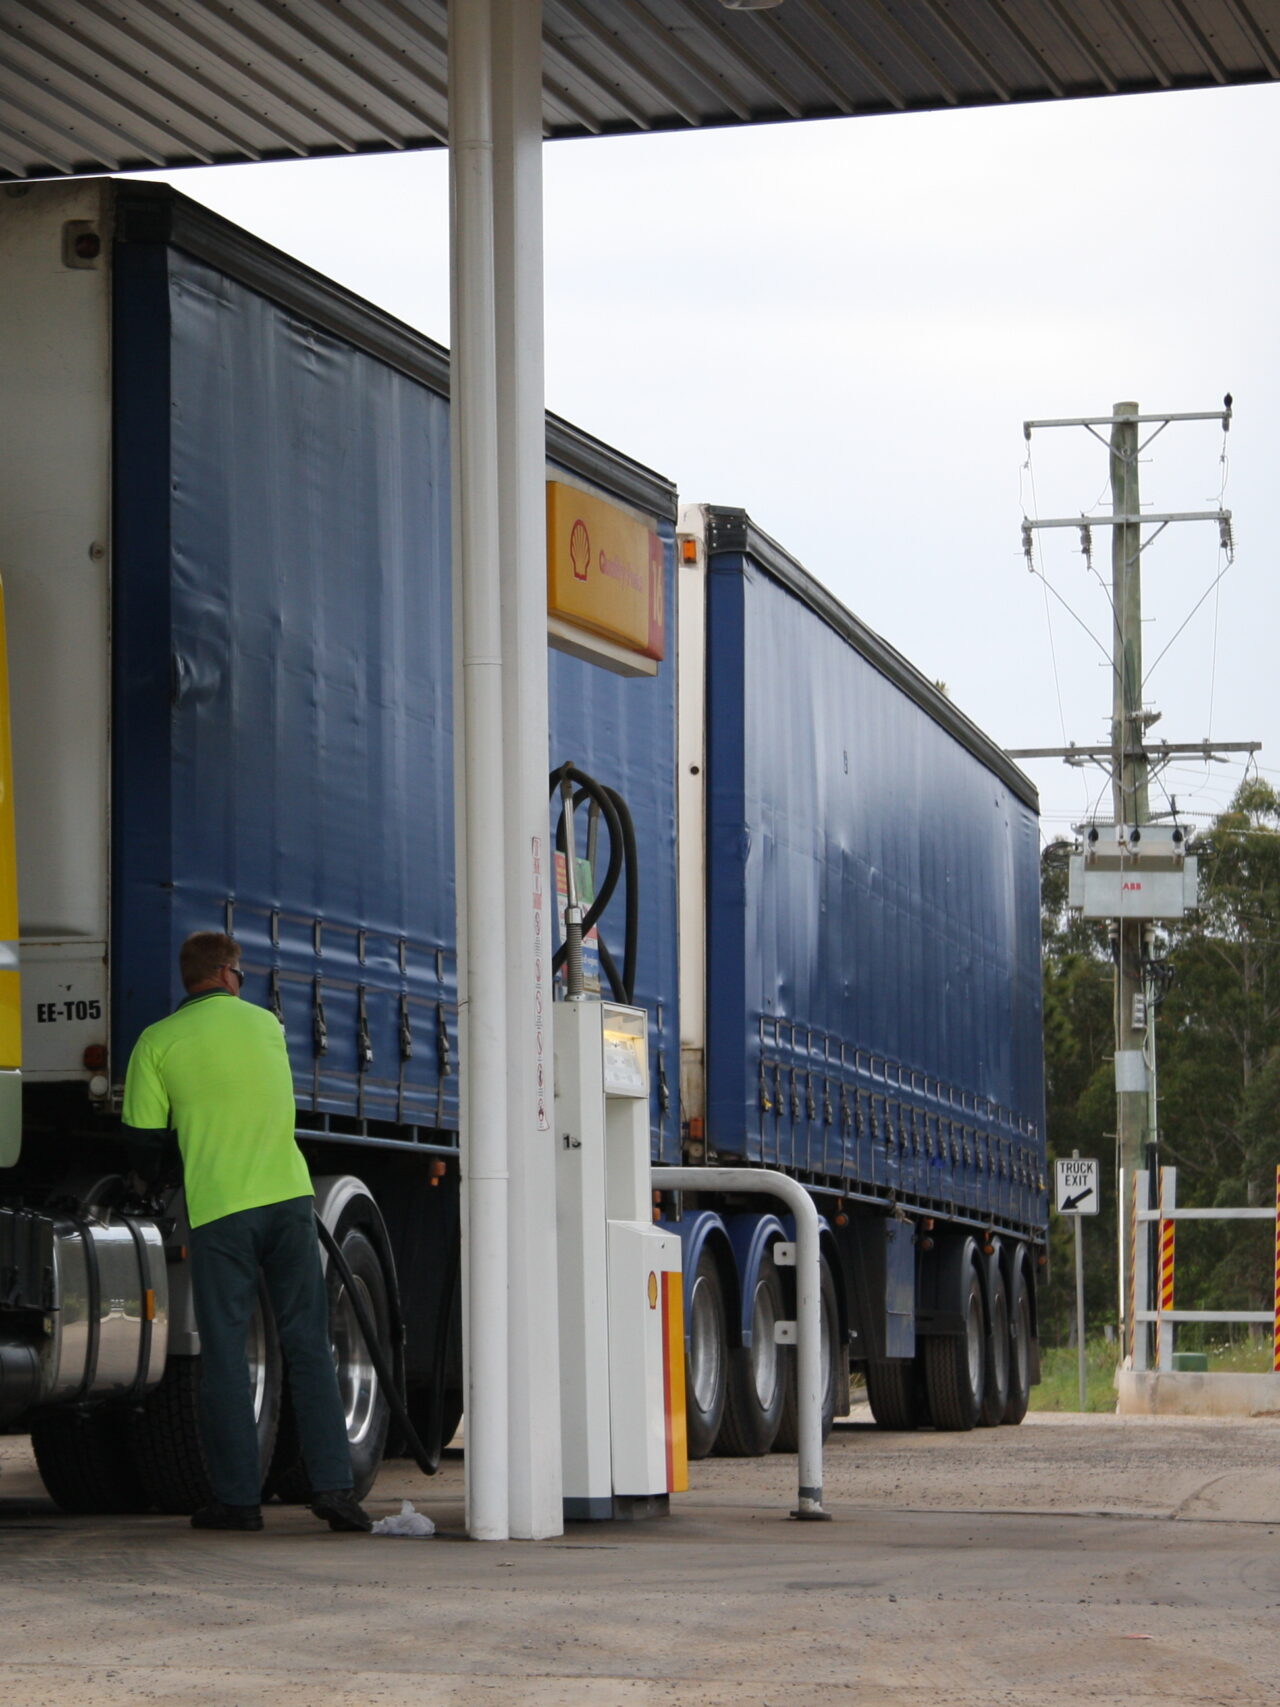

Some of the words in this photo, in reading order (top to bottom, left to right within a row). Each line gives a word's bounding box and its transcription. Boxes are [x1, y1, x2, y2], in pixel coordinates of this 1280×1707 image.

[651, 560, 664, 627] 16
[1123, 882, 1142, 891] ABB
[37, 999, 102, 1024] EE-T05
[1060, 1162, 1094, 1175] TRUCK
[1064, 1174, 1089, 1187] EXIT
